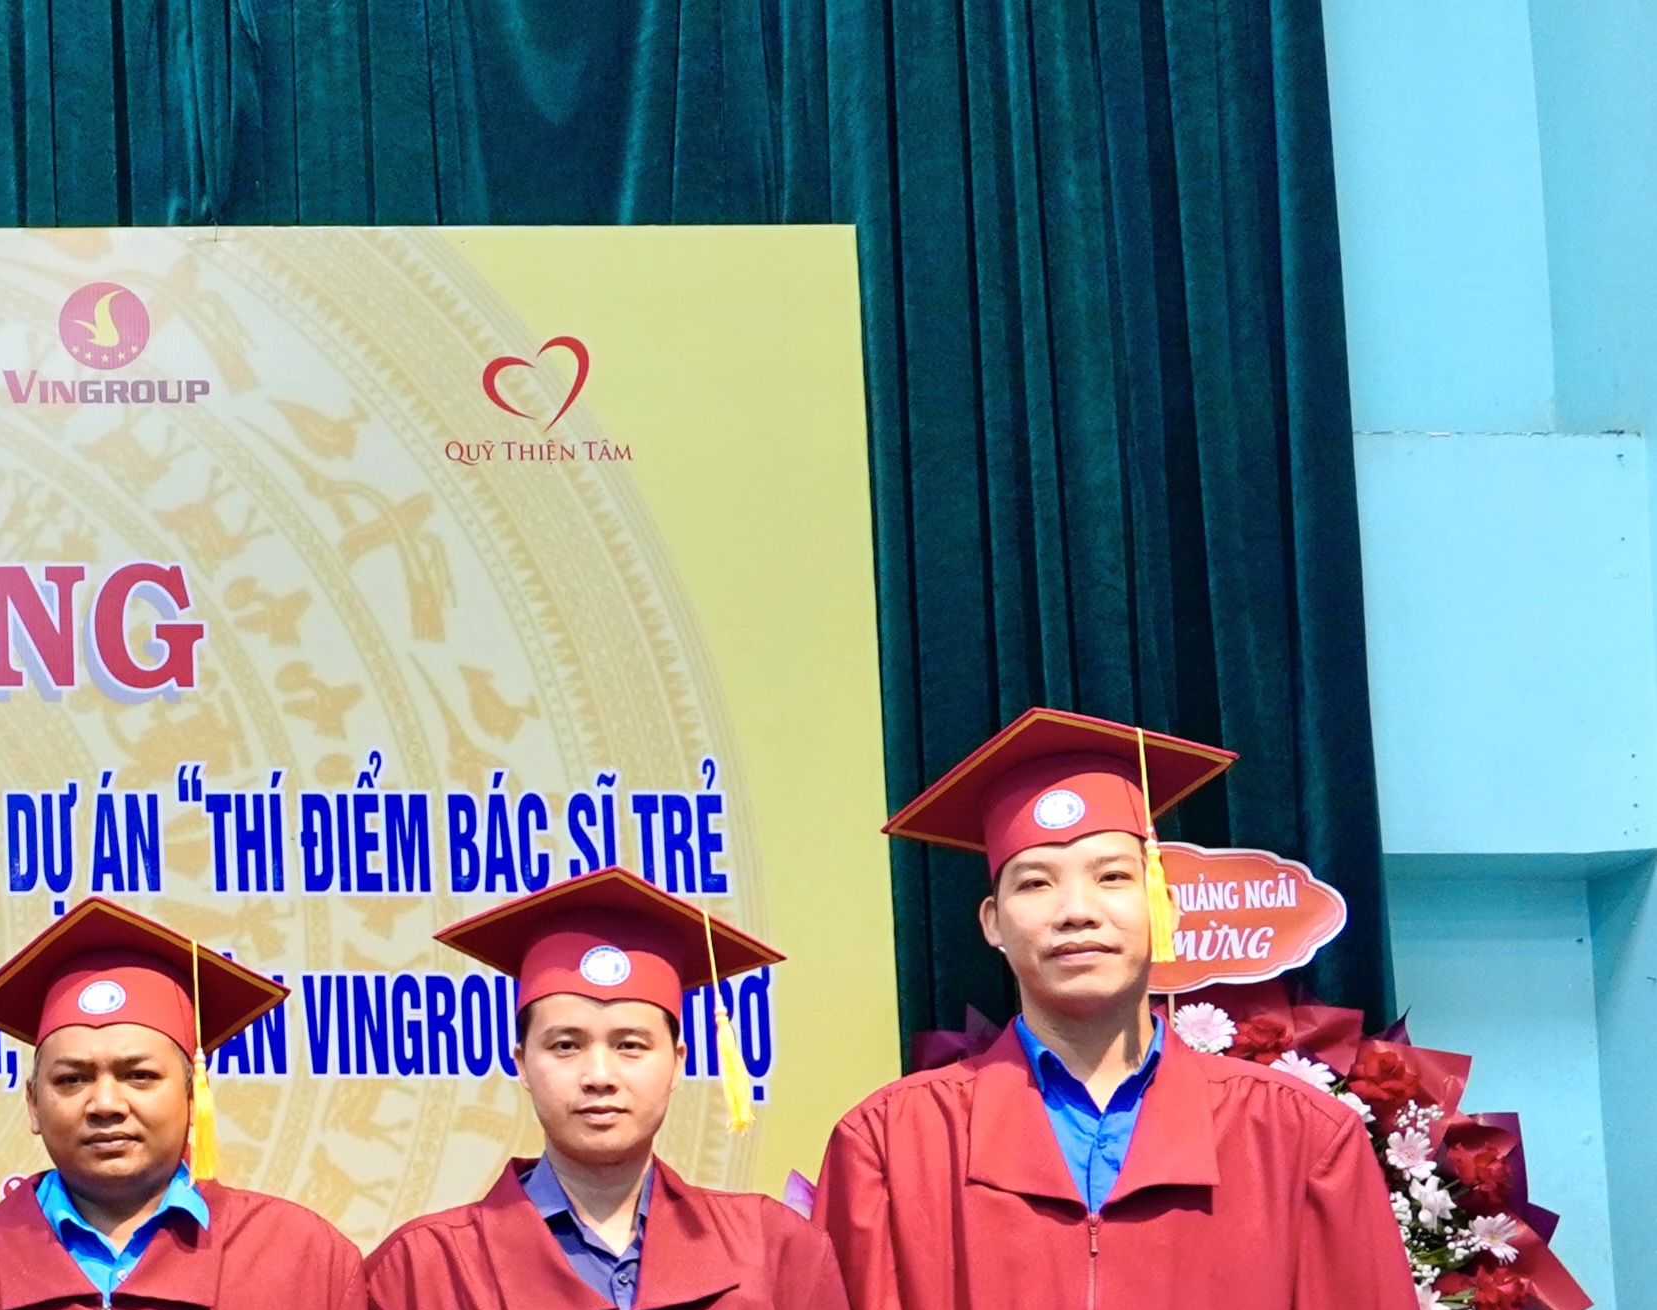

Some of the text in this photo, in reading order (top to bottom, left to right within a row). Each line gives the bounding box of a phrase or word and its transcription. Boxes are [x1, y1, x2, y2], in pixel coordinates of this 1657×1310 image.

[3, 370, 210, 404] VINGROUP
[445, 439, 633, 466] QUỸ THIỆN TÂM
[7, 784, 77, 915] DỰ
[92, 772, 160, 891] ÁN
[301, 752, 430, 892] ĐIỂM
[448, 772, 549, 892] BÁC
[568, 774, 615, 876] SĨ
[633, 759, 727, 892] TRẺ
[1244, 872, 1297, 909] NGÃI
